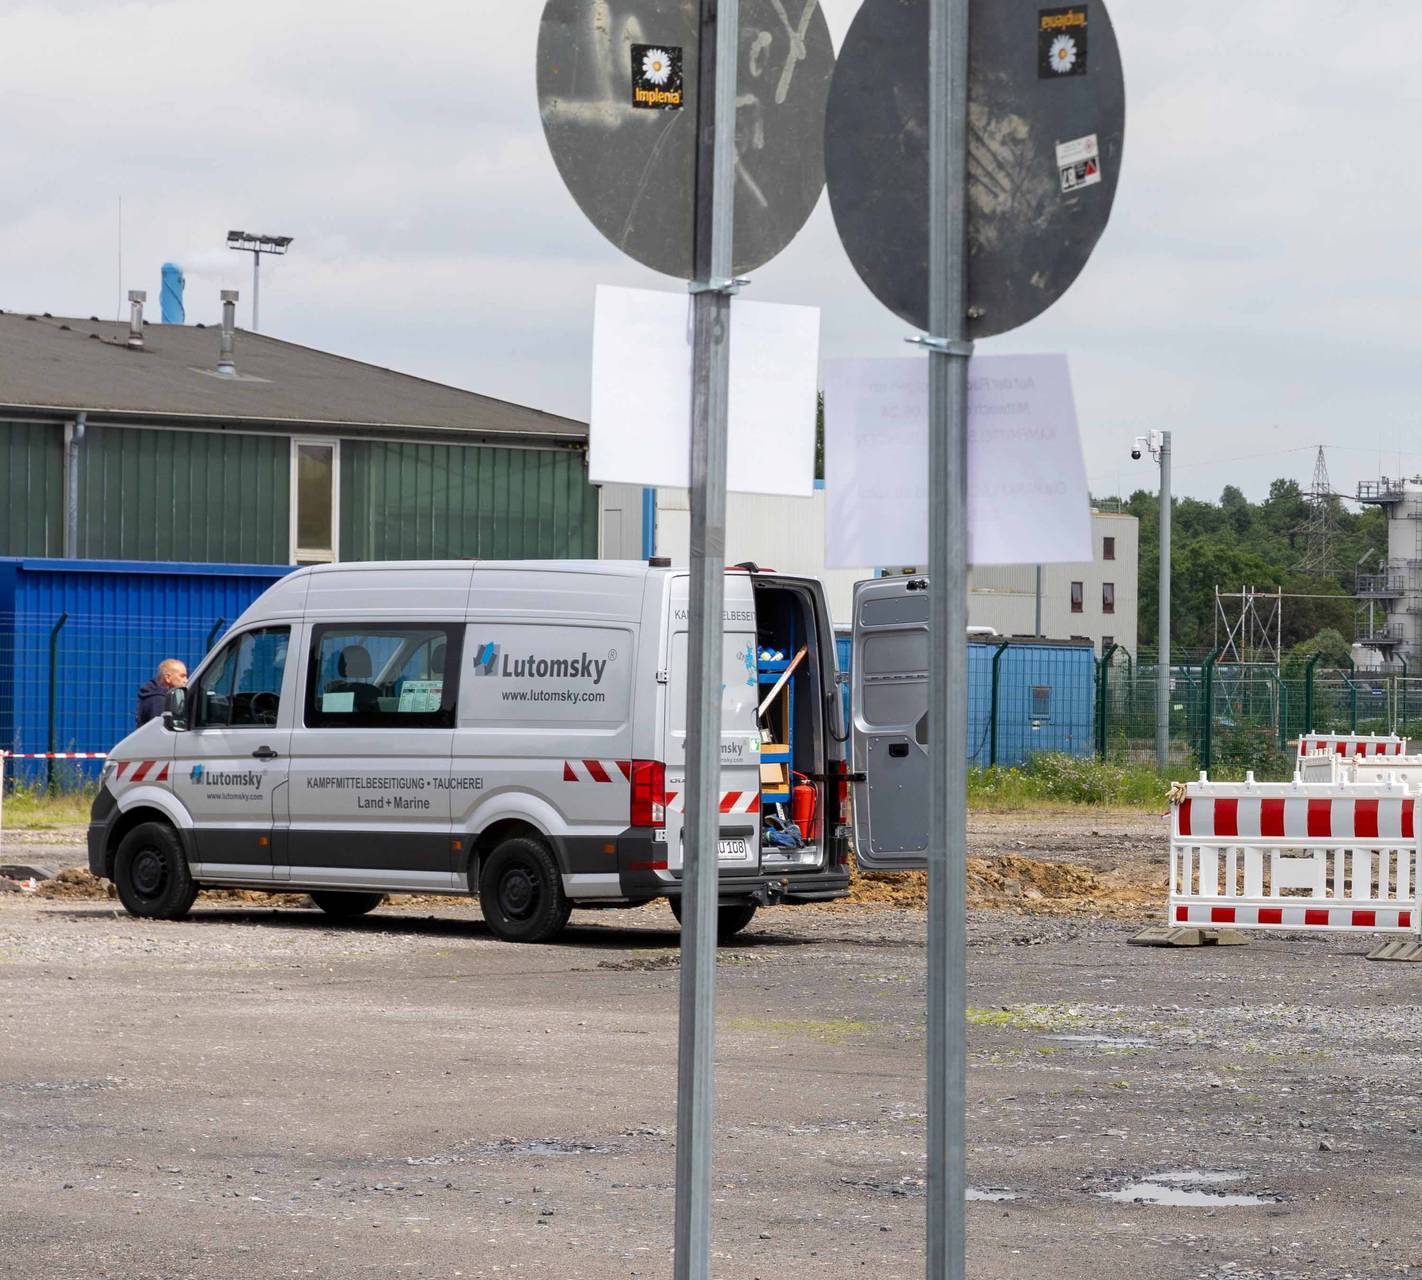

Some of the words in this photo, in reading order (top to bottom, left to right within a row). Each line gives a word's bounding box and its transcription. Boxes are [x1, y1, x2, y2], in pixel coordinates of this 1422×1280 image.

[635, 87, 680, 106] Implenia
[502, 689, 605, 704] www.lutomsky.com
[206, 770, 262, 789] Lutomsky
[306, 777, 425, 790] KAMPFMITTELBESEITIGUNG
[432, 777, 484, 790] TAUCHEREI
[357, 796, 384, 809] Land
[393, 796, 430, 809] Marine
[727, 841, 744, 853] 108
